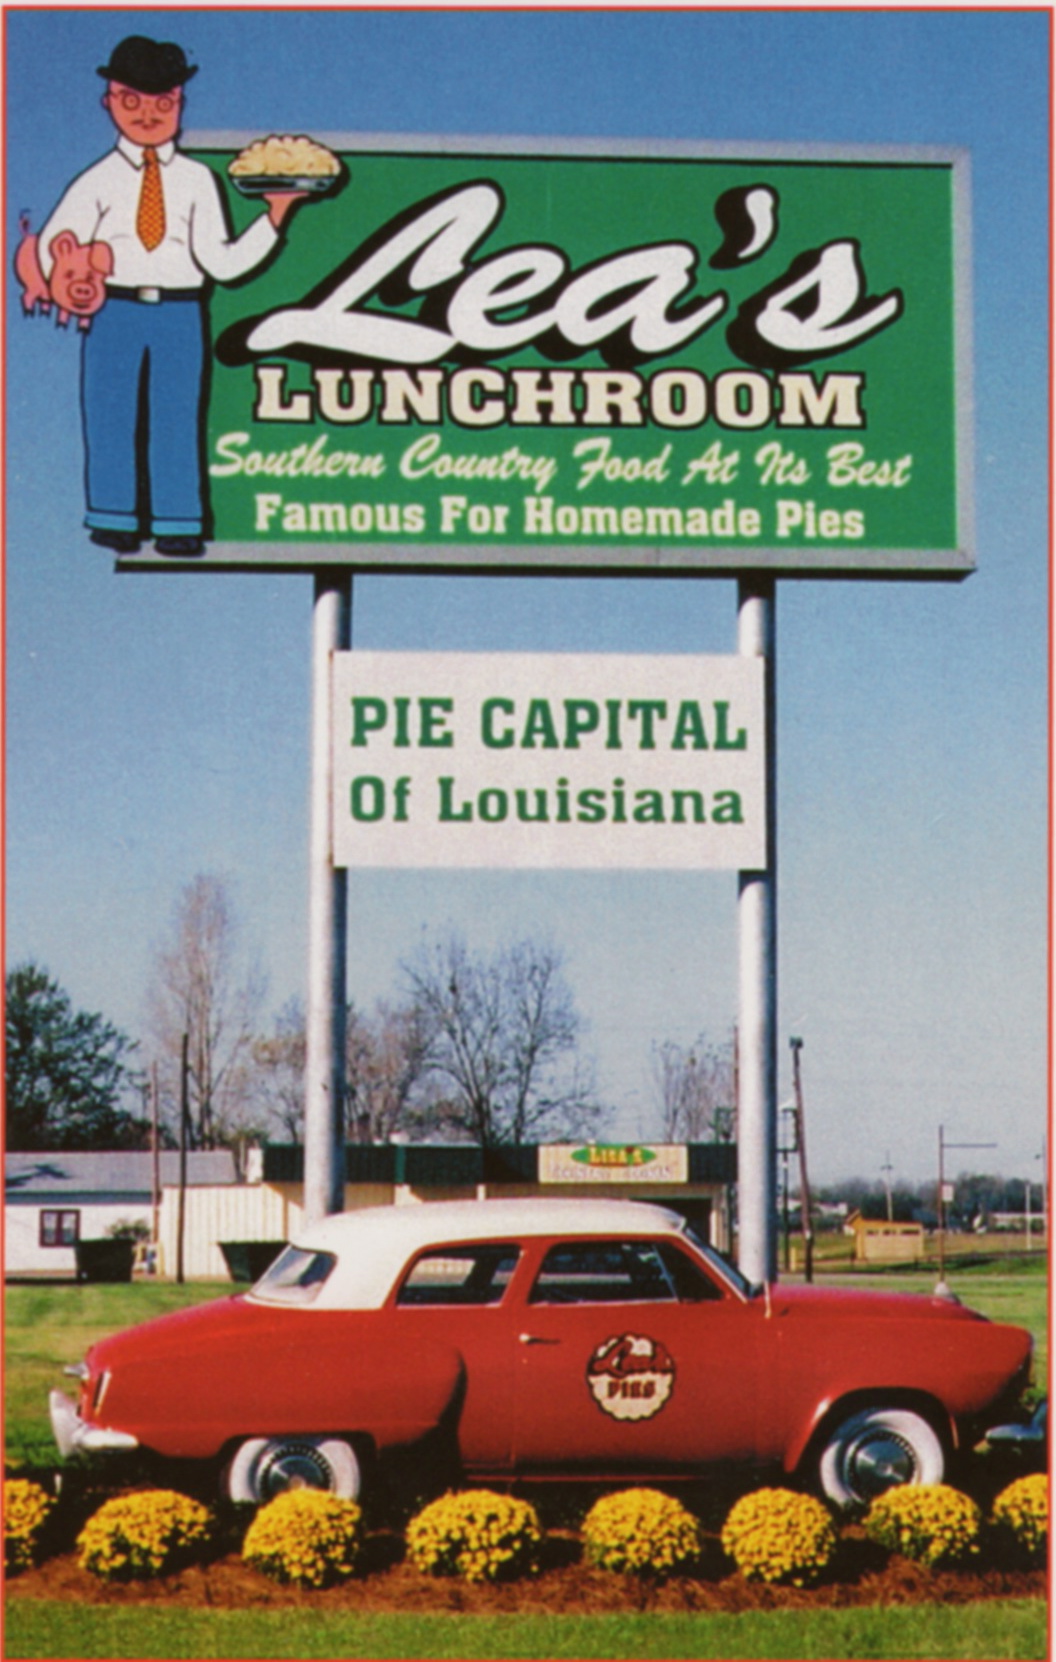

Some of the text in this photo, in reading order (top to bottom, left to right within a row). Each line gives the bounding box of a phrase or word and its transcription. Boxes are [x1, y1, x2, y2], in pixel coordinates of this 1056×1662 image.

[244, 179, 898, 364] Lea's
[255, 366, 864, 427] LUNCHROOM
[209, 432, 912, 492] Southern Country Food At Its Best
[255, 493, 865, 539] Famous For Homemade Pies
[351, 697, 747, 751] PIE CAPITAL
[350, 775, 744, 825] Of Louisiana
